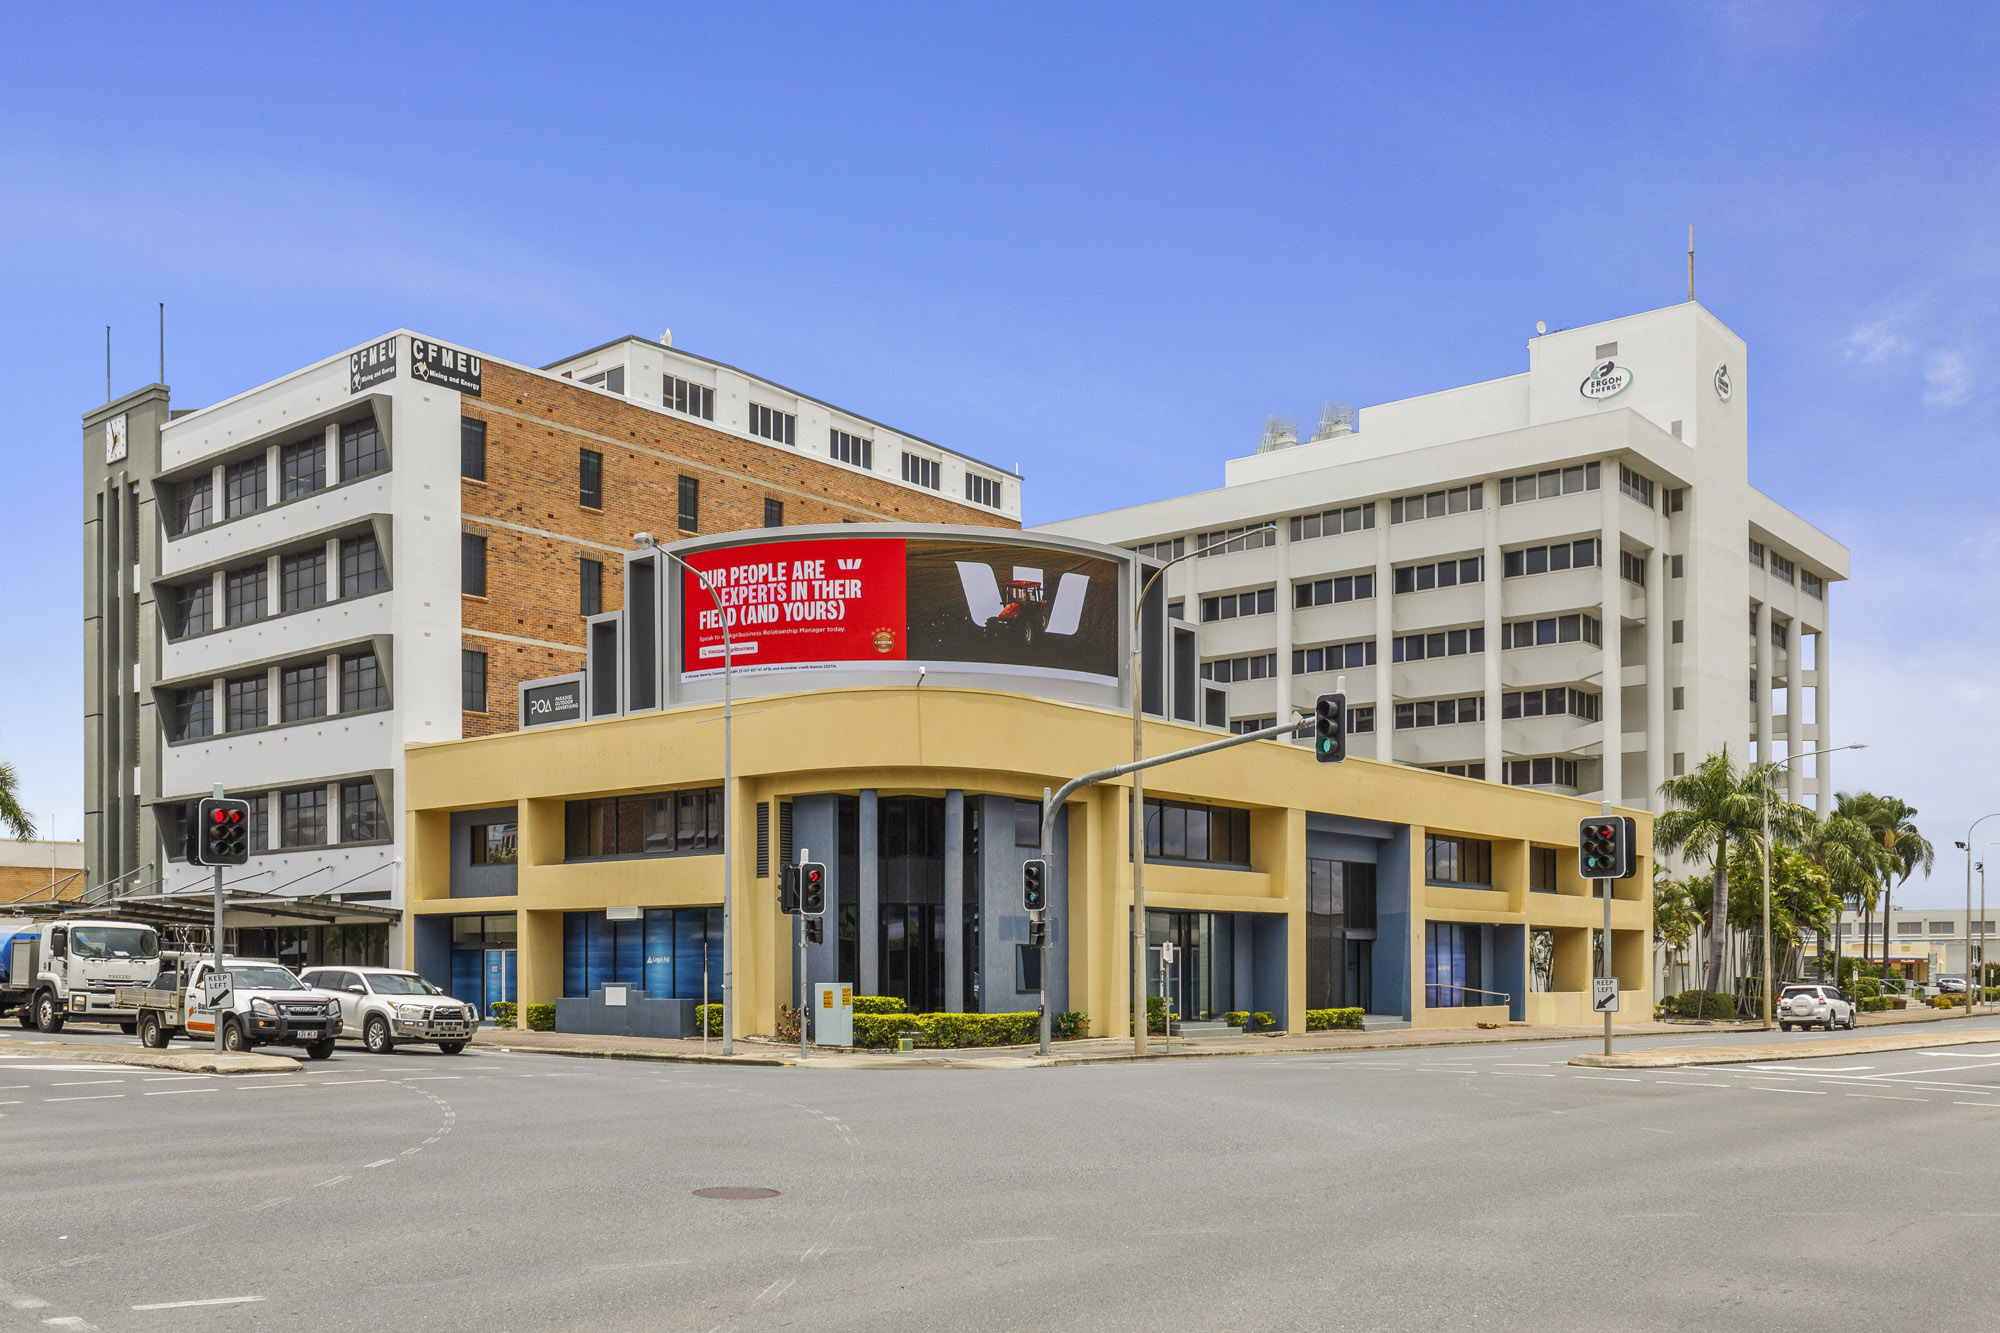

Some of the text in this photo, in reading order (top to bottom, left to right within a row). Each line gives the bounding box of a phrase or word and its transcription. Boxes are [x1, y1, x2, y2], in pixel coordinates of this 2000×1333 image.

[351, 338, 396, 374] CFMEU
[413, 339, 480, 377] CFMEU
[361, 374, 374, 382] Mining
[382, 366, 395, 375] Energy
[430, 370, 448, 382] Mining
[460, 378, 480, 390] Energy
[1590, 376, 1622, 388] ERGON
[1590, 383, 1622, 394] ENERGY
[699, 560, 825, 590] OUR PEOPLE ARE
[721, 579, 862, 607] EXPERTS IN THEIR
[740, 603, 779, 626] (AND
[782, 600, 845, 622] YOURS)
[728, 630, 762, 640] Agribusiness
[762, 628, 798, 636] Relationship
[800, 626, 826, 634] Manager
